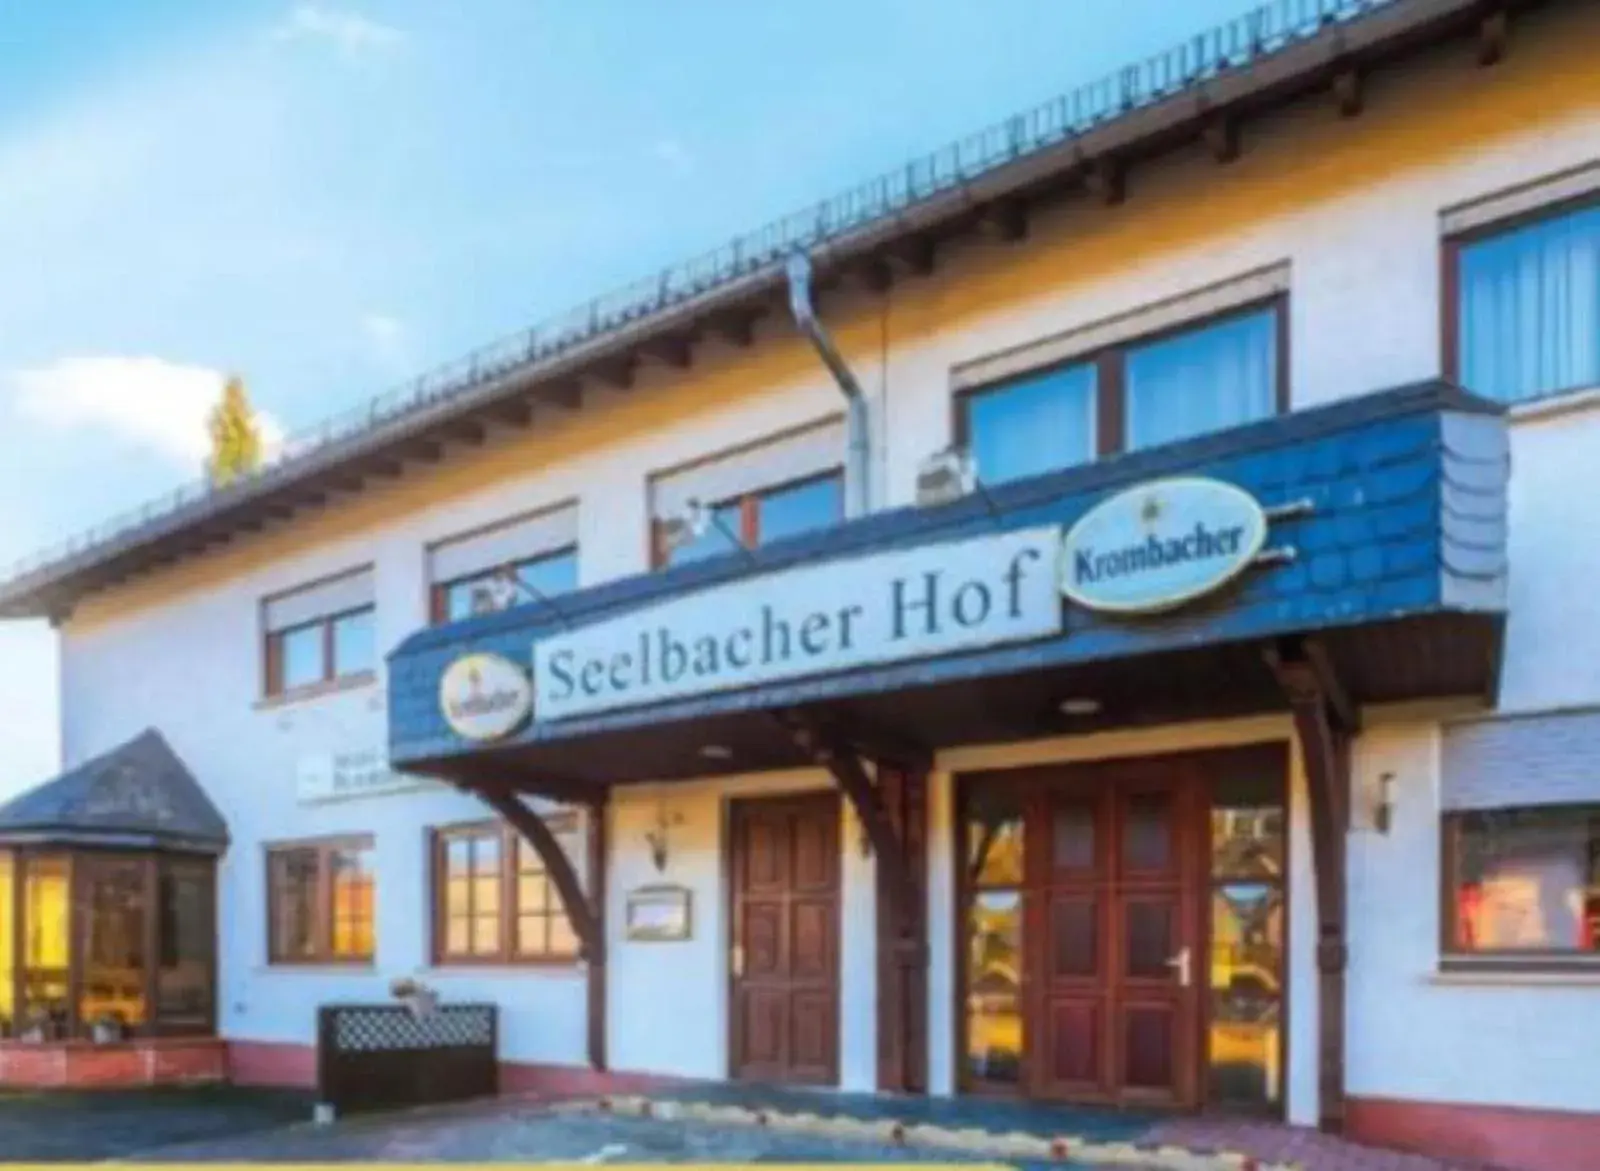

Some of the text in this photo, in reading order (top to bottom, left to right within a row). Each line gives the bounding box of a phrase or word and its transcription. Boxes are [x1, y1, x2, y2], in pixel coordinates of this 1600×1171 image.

[1074, 520, 1244, 585] Krombacher
[547, 546, 1041, 700] Seelbacher Hof
